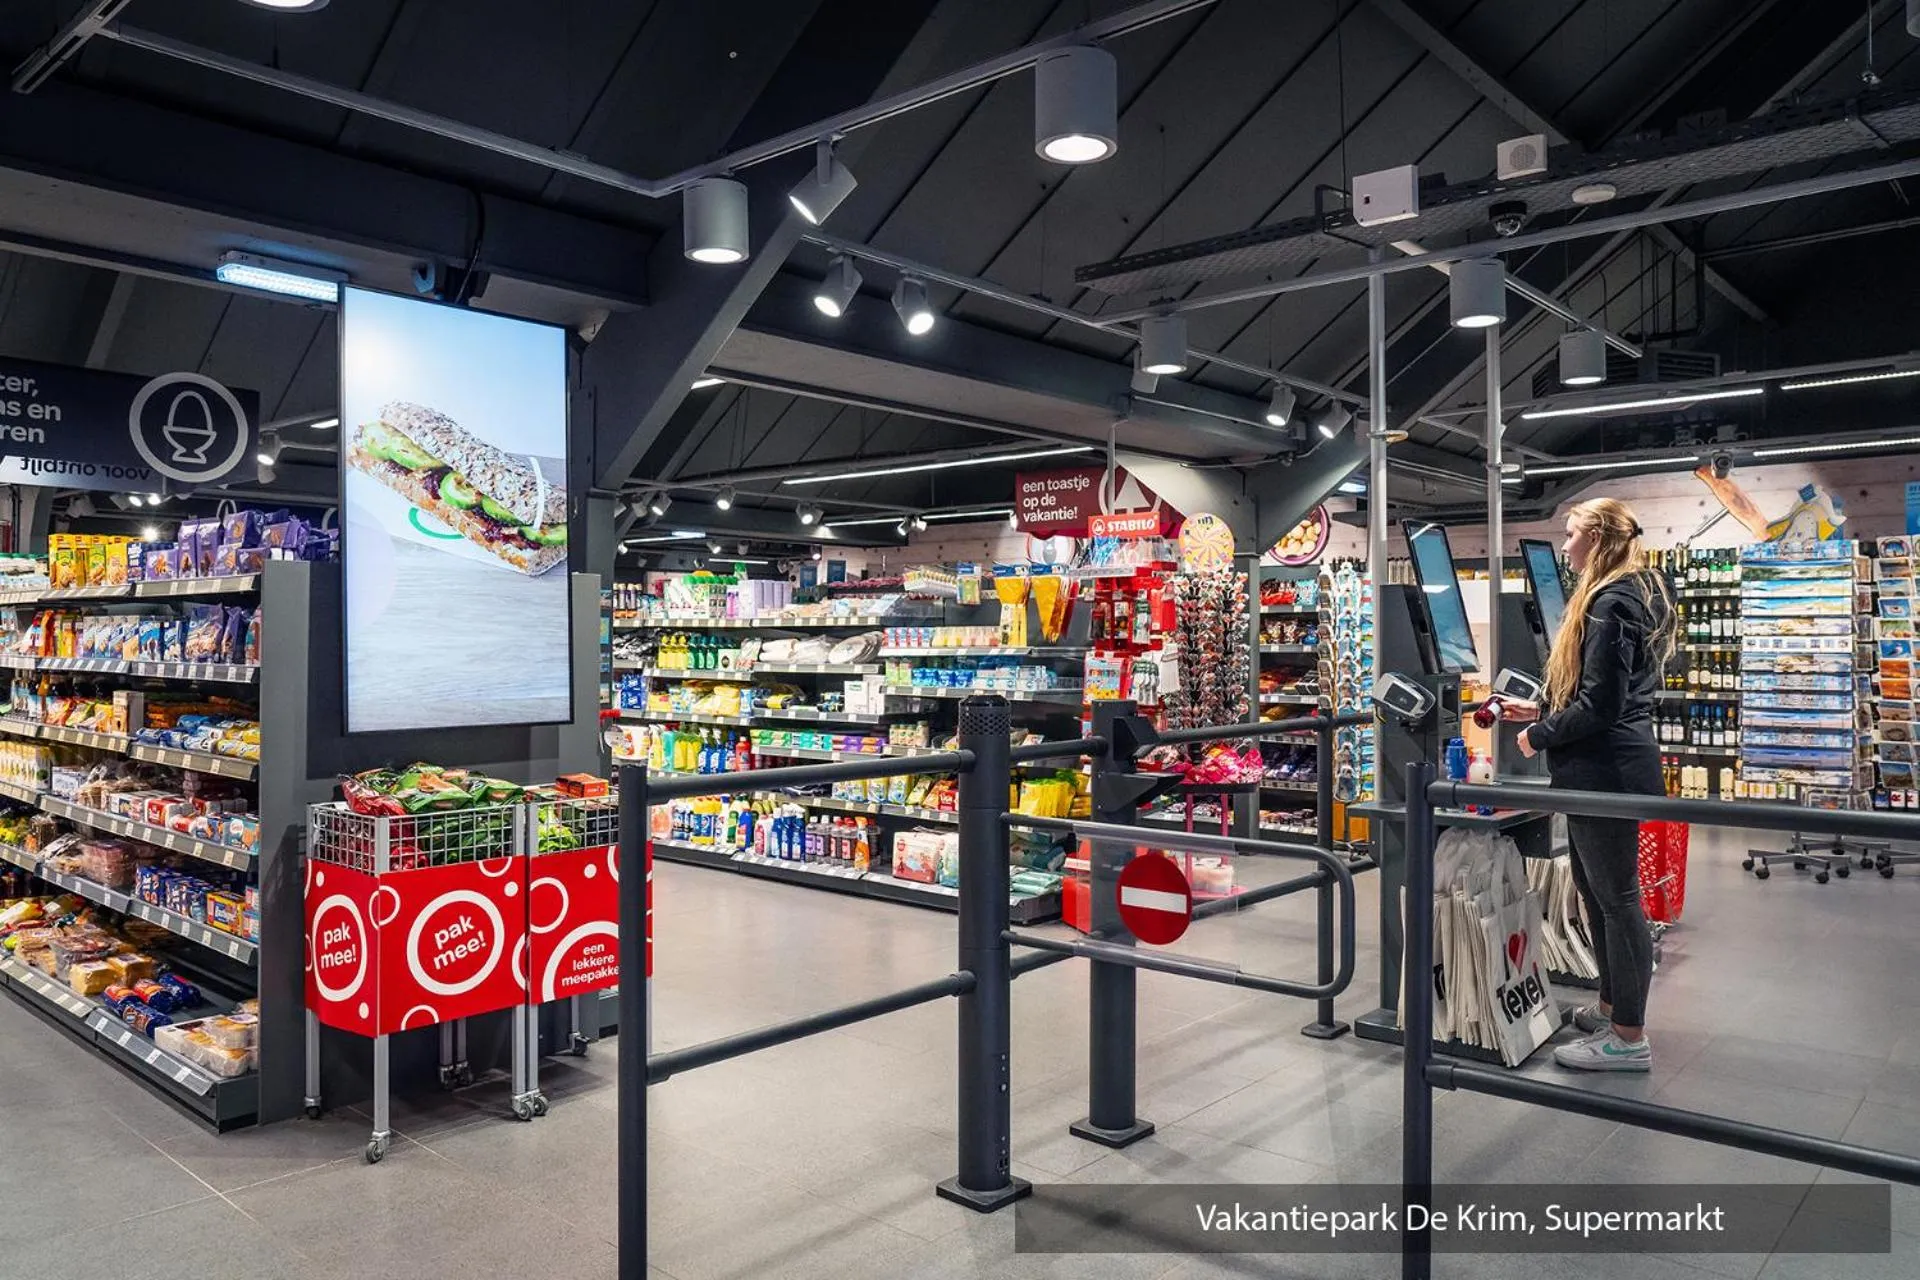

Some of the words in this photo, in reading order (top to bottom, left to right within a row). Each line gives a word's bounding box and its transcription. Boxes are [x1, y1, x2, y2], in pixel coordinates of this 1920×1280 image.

[27, 403, 61, 421] en
[1023, 481, 1045, 493] een
[1047, 475, 1090, 491] toastje
[1023, 497, 1039, 510] op
[1041, 493, 1056, 506] de
[1023, 506, 1078, 522] vakantie!
[323, 921, 351, 950] pak
[434, 915, 475, 950] pak
[321, 944, 356, 969] mee!
[433, 930, 487, 969] mee!
[583, 944, 605, 955] een
[572, 954, 615, 971] lekkere
[1496, 960, 1545, 1024] Texel
